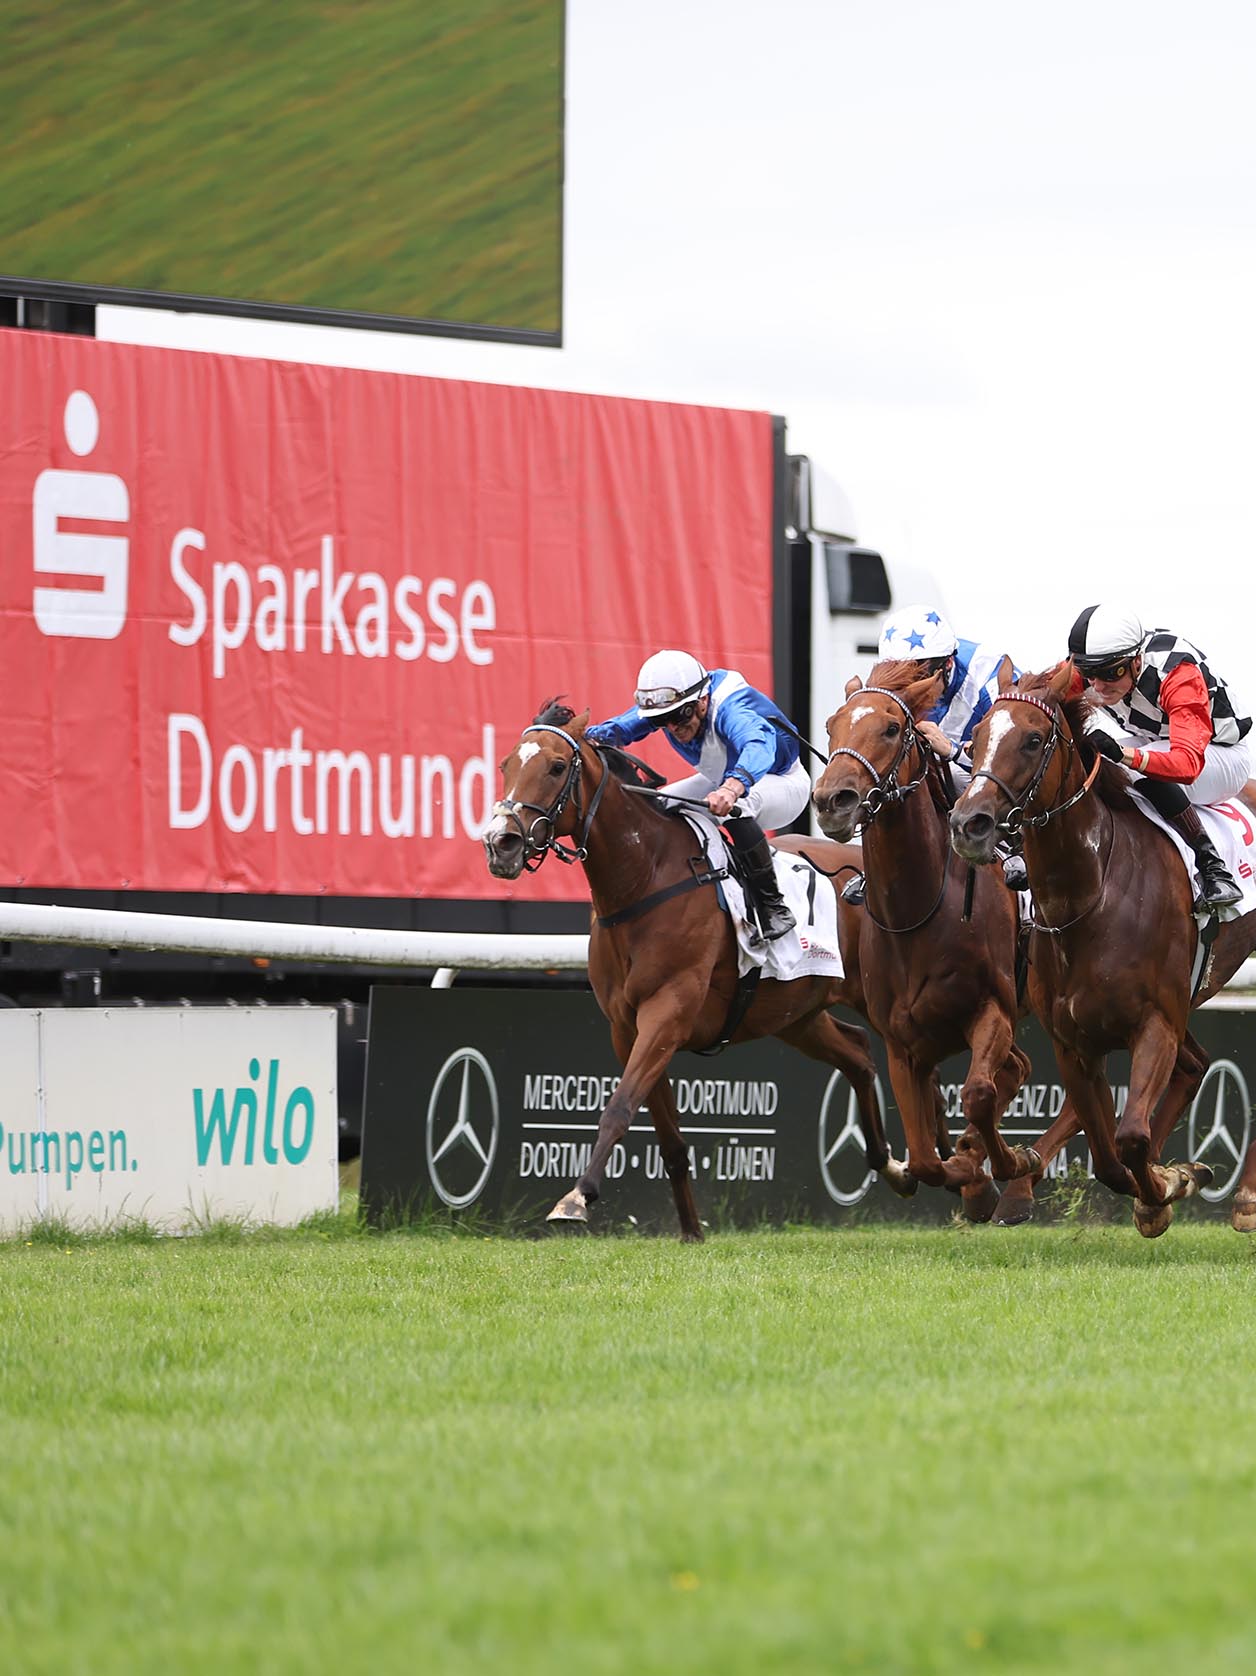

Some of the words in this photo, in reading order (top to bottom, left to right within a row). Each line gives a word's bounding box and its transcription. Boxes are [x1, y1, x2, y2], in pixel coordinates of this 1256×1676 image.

[168, 527, 496, 679] Sparkasse
[168, 712, 494, 841] Dortmund
[791, 864, 816, 926] 7
[193, 1057, 315, 1166] wilo
[677, 1079, 779, 1116] DORTMUND
[716, 1137, 776, 1181] LÜNEN
